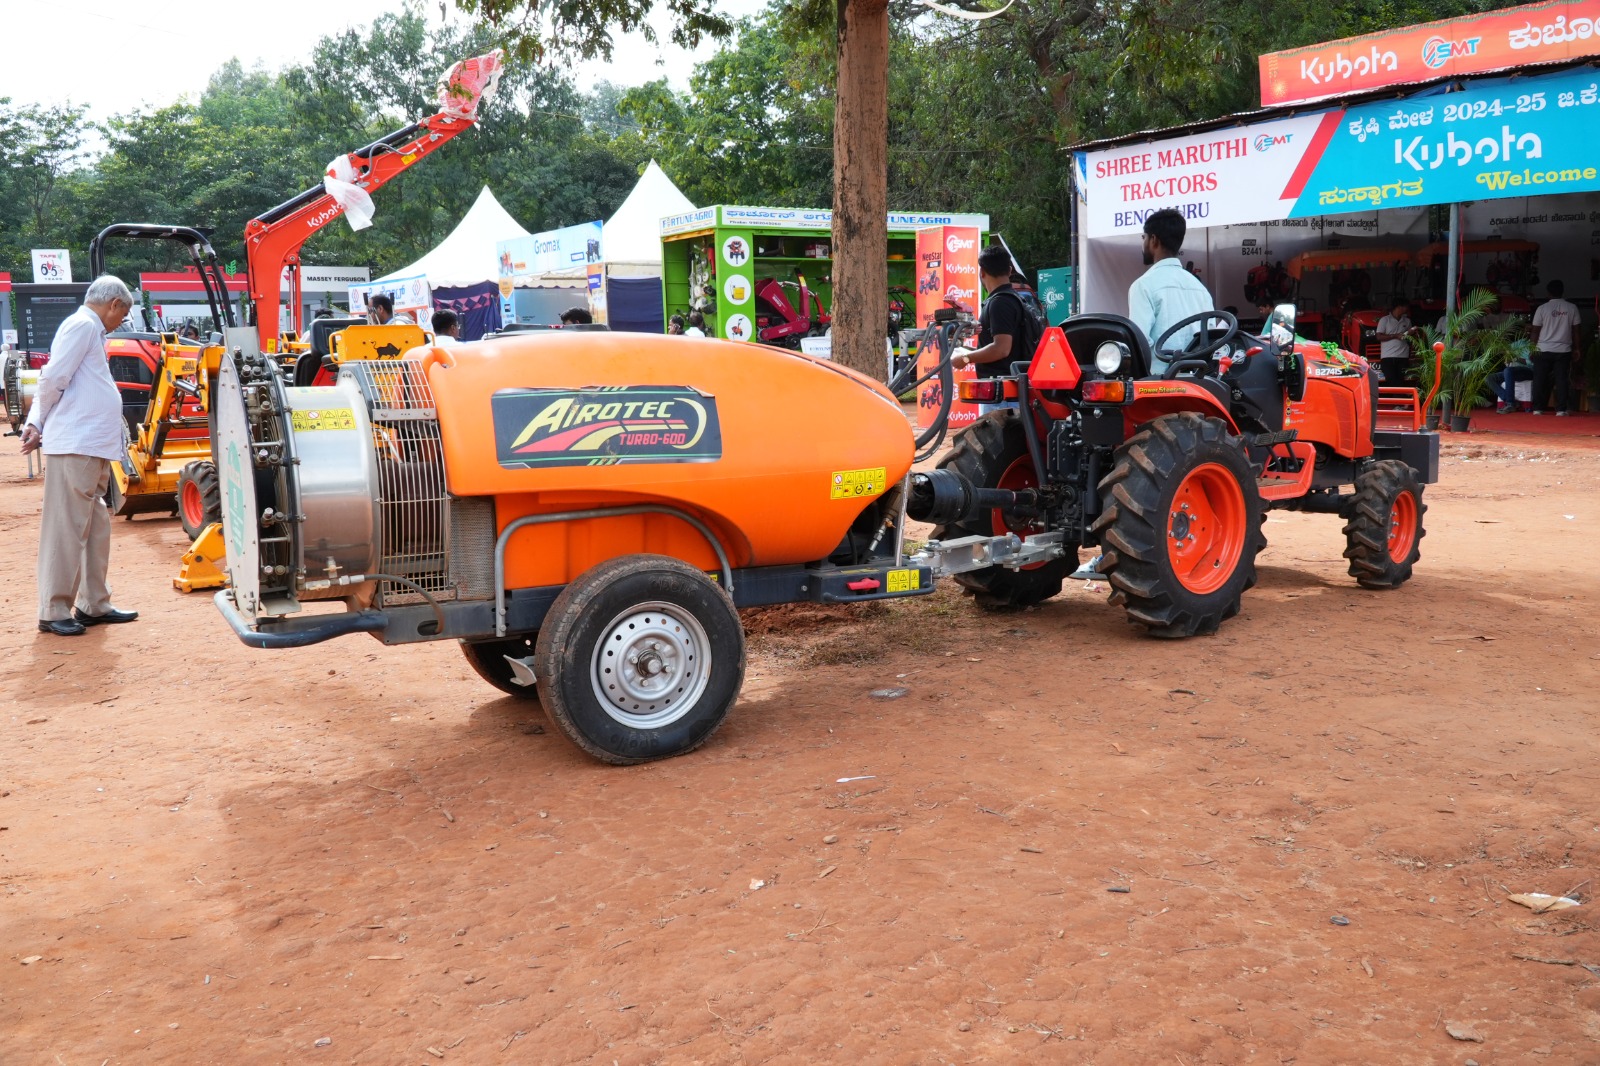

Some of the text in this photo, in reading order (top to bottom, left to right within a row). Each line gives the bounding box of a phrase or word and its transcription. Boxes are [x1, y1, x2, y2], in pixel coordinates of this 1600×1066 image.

[1437, 37, 1482, 59] SMT
[1301, 46, 1397, 84] Kubota
[1349, 117, 1380, 142] ಕೃಷಿ
[1388, 106, 1434, 130] ಮೇಳ
[1443, 92, 1547, 123] 2024-25
[1263, 133, 1294, 145] SMT
[1394, 125, 1542, 171] Kubota
[1095, 137, 1248, 179] SHREE MARUTHI
[1120, 172, 1218, 202] TRACTORS
[1476, 167, 1597, 190] Welcome
[1319, 177, 1424, 206] ಸುಸ್ವಾಗತ
[534, 239, 561, 255] Gromax
[954, 238, 975, 249] SMT
[306, 275, 332, 283] MASSEY
[946, 263, 976, 275] Kubota
[510, 398, 675, 449] AIROTEC
[619, 433, 686, 445] TURBO-600
